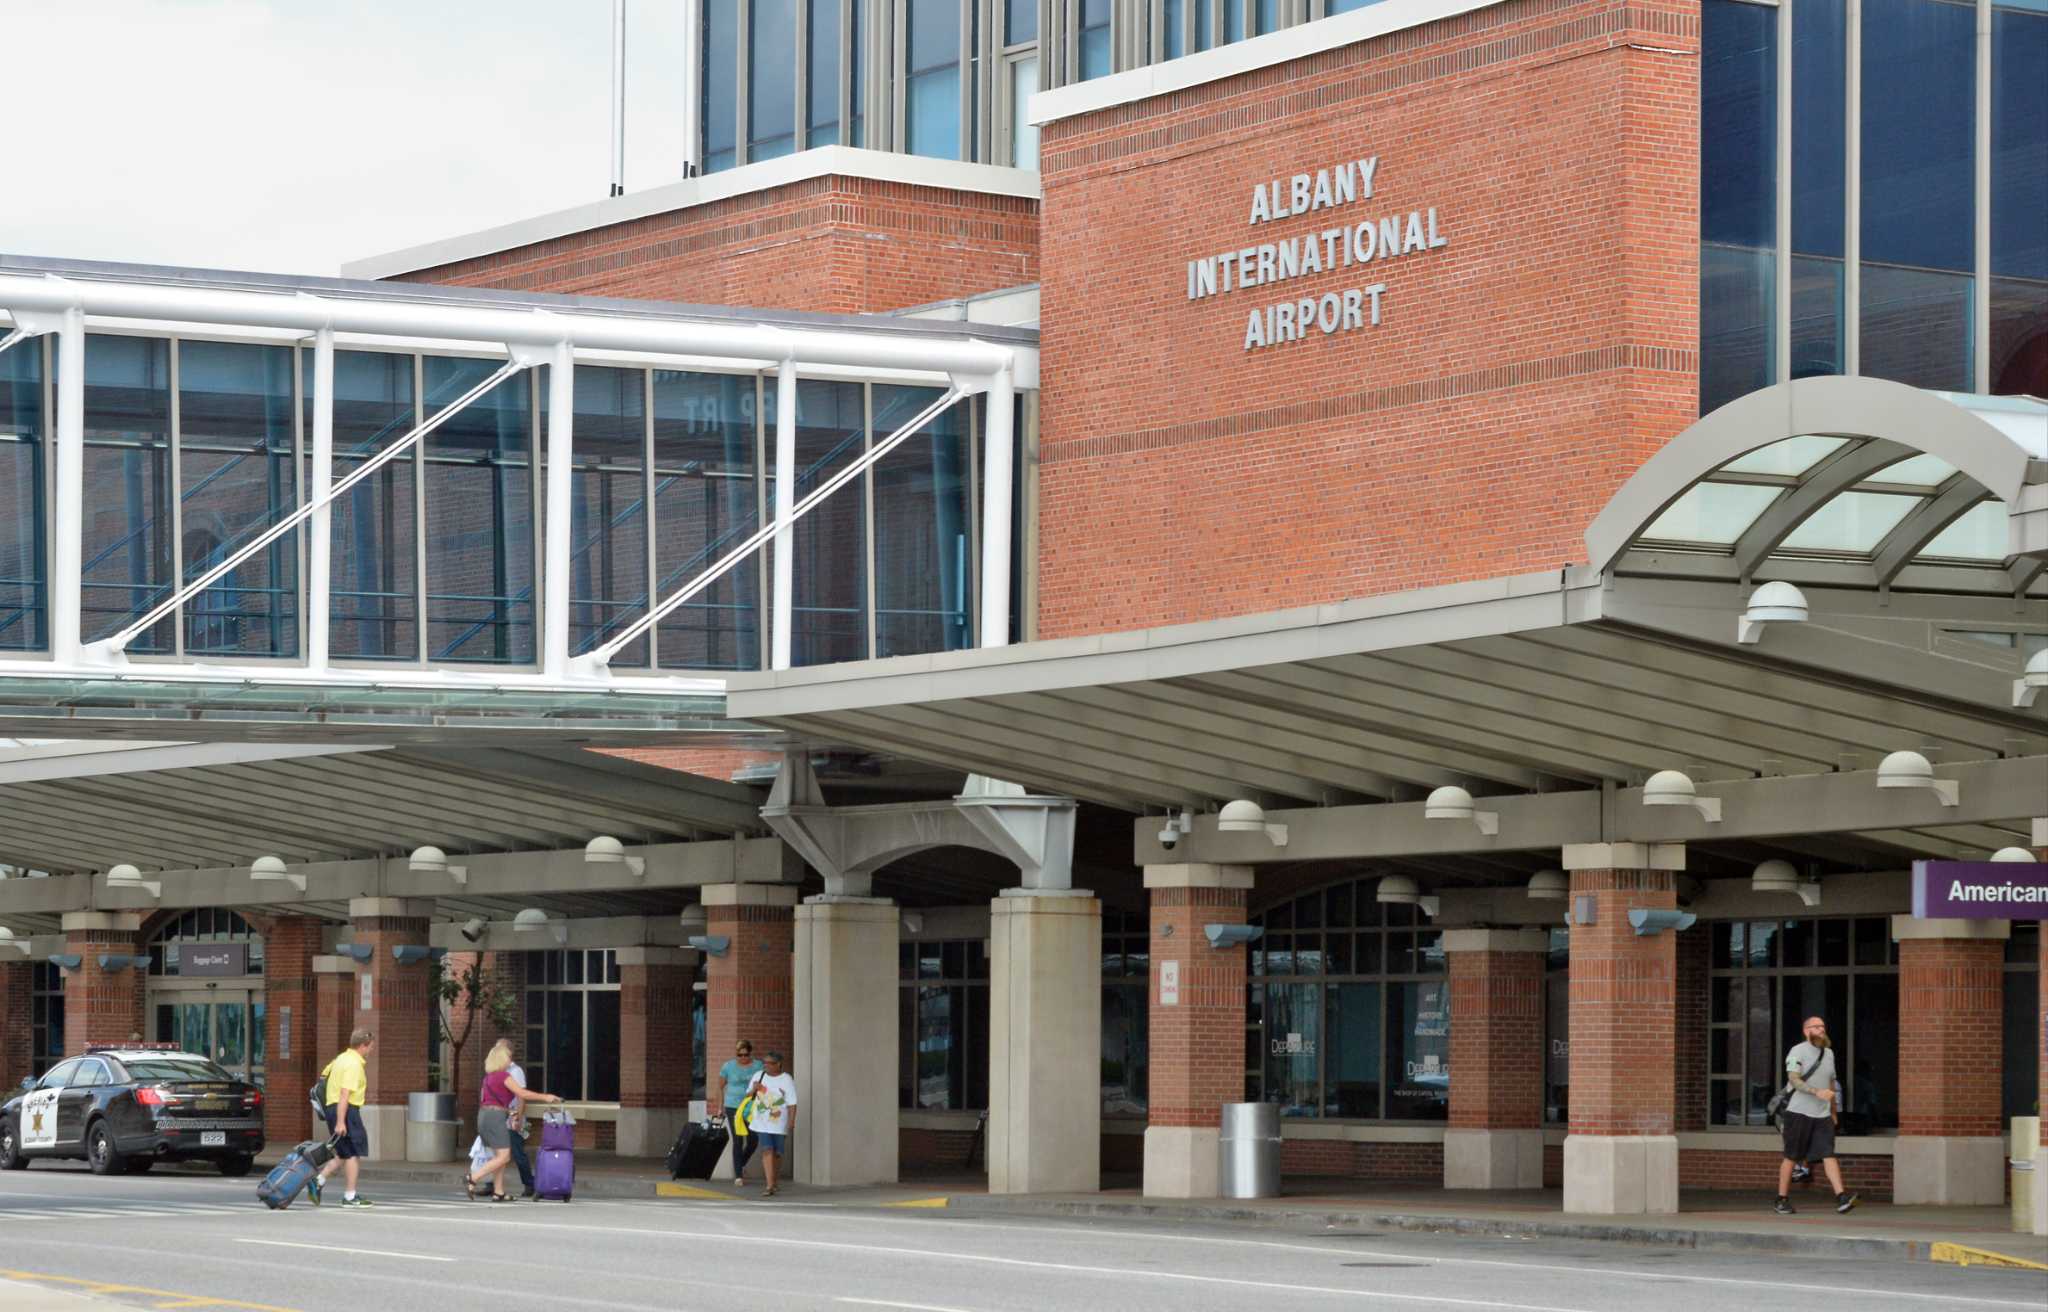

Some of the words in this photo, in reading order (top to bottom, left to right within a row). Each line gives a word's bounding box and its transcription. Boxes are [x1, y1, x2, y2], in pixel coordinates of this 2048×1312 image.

[1249, 156, 1378, 225] ALBANY
[1187, 207, 1448, 300] INTERNATIONAL
[1243, 283, 1386, 350] AIRPORT
[1947, 879, 2048, 903] American
